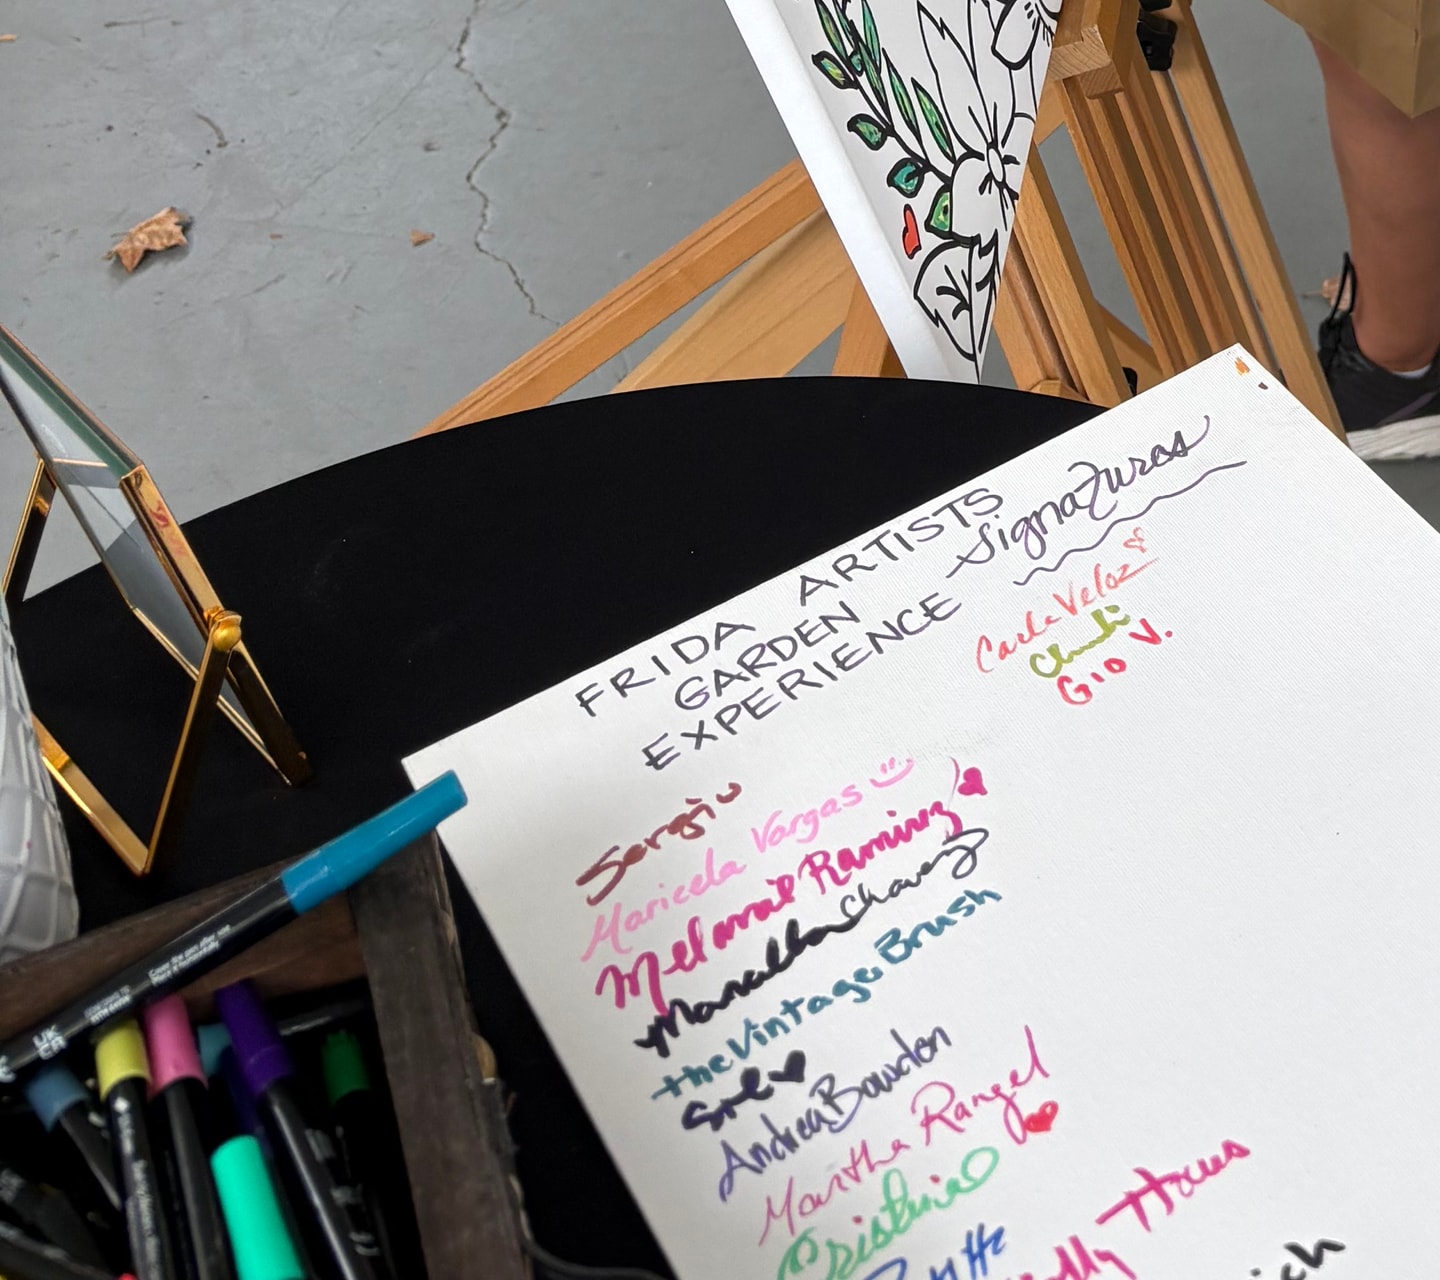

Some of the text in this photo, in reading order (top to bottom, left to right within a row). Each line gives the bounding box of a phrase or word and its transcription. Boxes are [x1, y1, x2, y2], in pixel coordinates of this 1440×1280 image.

[574, 620, 755, 718] FRIDA
[799, 486, 1004, 606] ARTISTS
[642, 591, 963, 771] EXPERIENCE
[674, 600, 862, 711] GARDEN
[581, 784, 864, 963] Maricela Vargas
[874, 886, 1004, 965] Brush
[759, 1025, 1051, 1247] Martha Rangel
